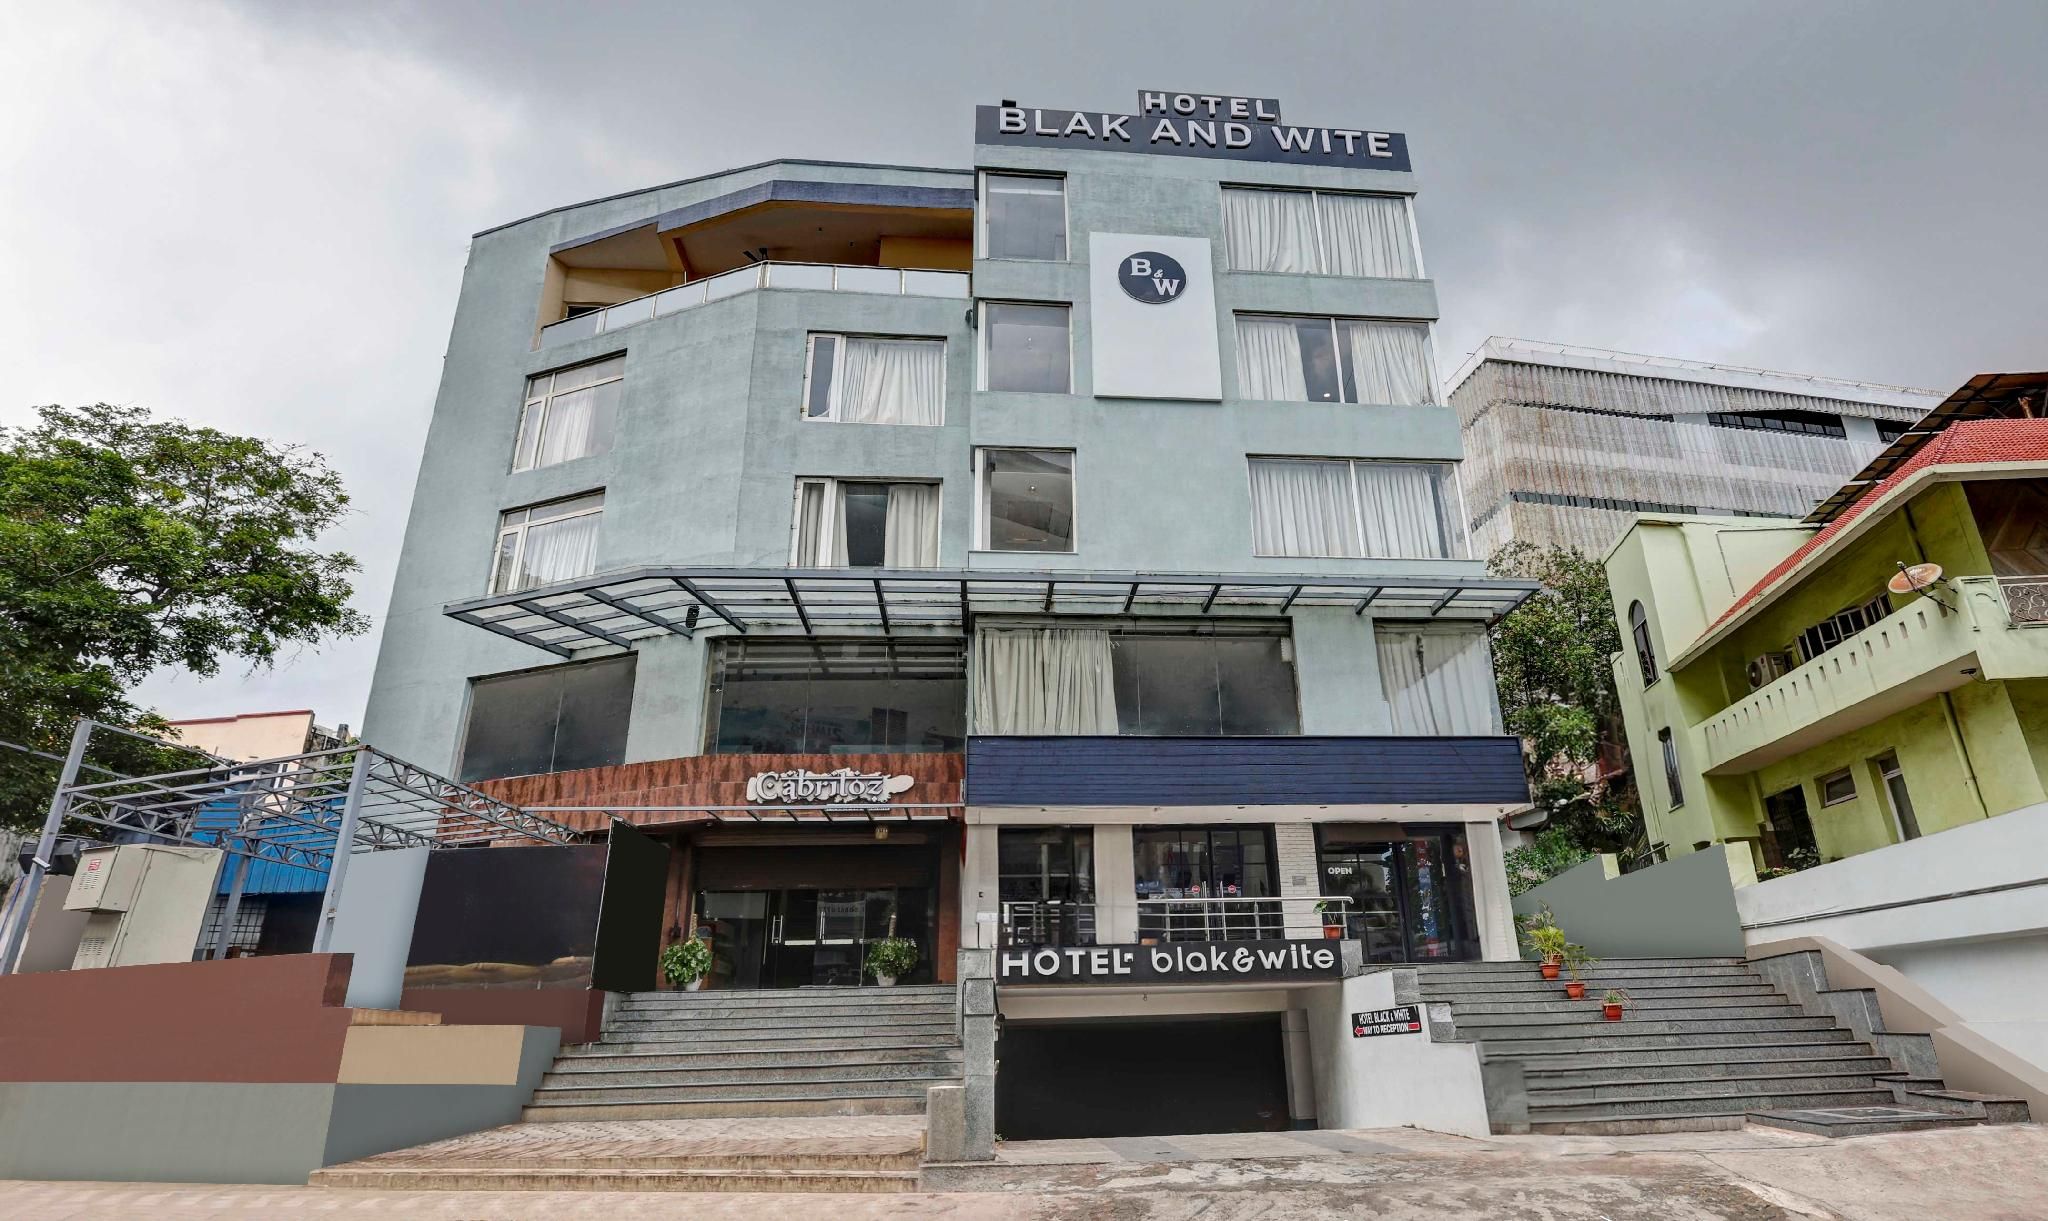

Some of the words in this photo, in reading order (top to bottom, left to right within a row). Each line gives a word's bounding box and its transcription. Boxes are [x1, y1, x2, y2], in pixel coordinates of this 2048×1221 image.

[1144, 92, 1276, 120] HOTEL
[998, 107, 1131, 142] BLAK
[1150, 119, 1252, 149] AND
[1271, 125, 1393, 157] WITE
[1327, 867, 1352, 875] OPEN
[1002, 947, 1132, 977] HOTEL
[1151, 943, 1336, 974] blak&wite
[1358, 1013, 1374, 1024] HOTEL
[1374, 1011, 1390, 1023] BLACK
[1393, 1009, 1411, 1021] WHITE
[1373, 1025, 1380, 1034] TO
[1380, 1023, 1409, 1034] RECEPTION
